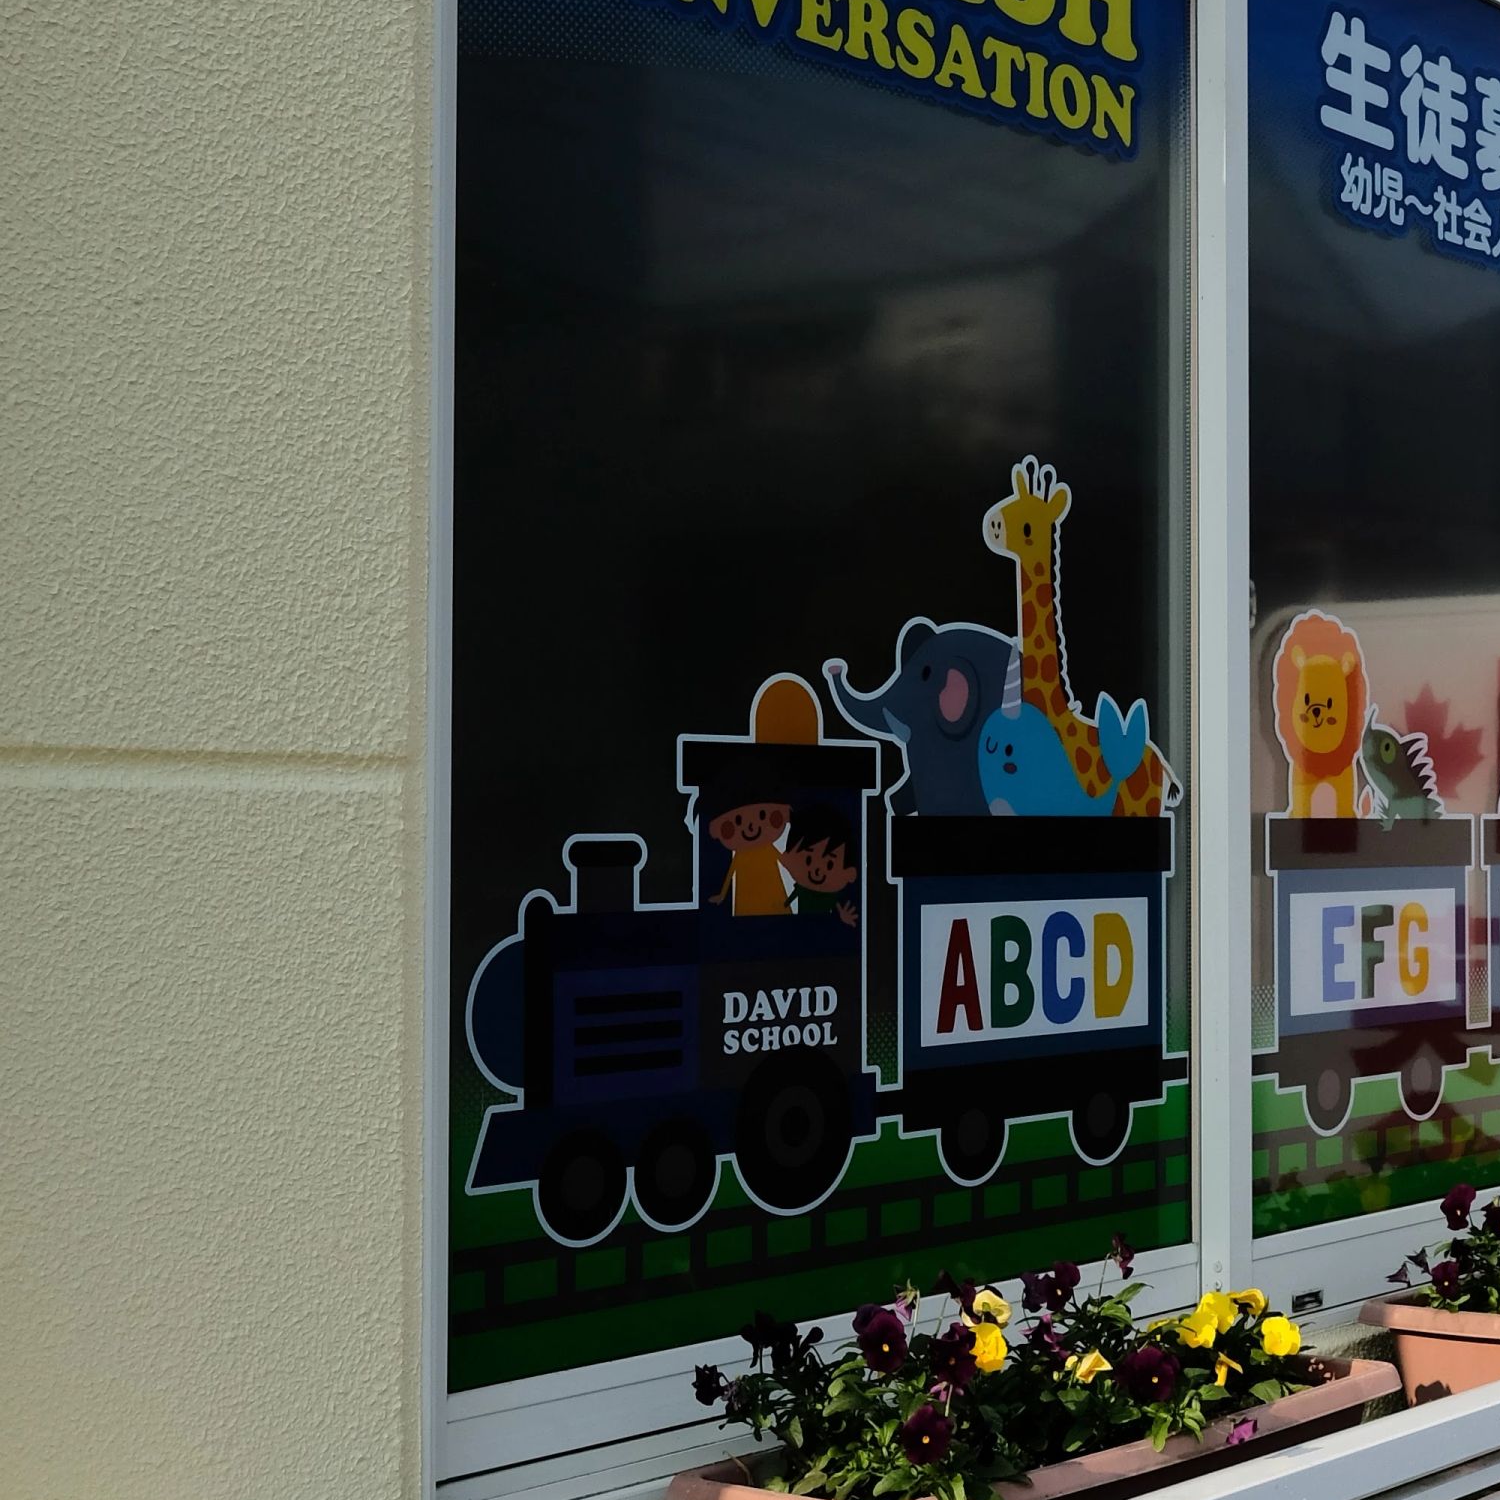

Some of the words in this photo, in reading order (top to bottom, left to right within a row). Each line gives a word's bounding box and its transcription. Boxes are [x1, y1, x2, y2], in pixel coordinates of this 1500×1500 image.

[936, 911, 1134, 1034] ABCD
[1322, 902, 1430, 1002] EFG
[723, 986, 838, 1023] DAVID
[723, 1022, 838, 1055] SCHOOL
